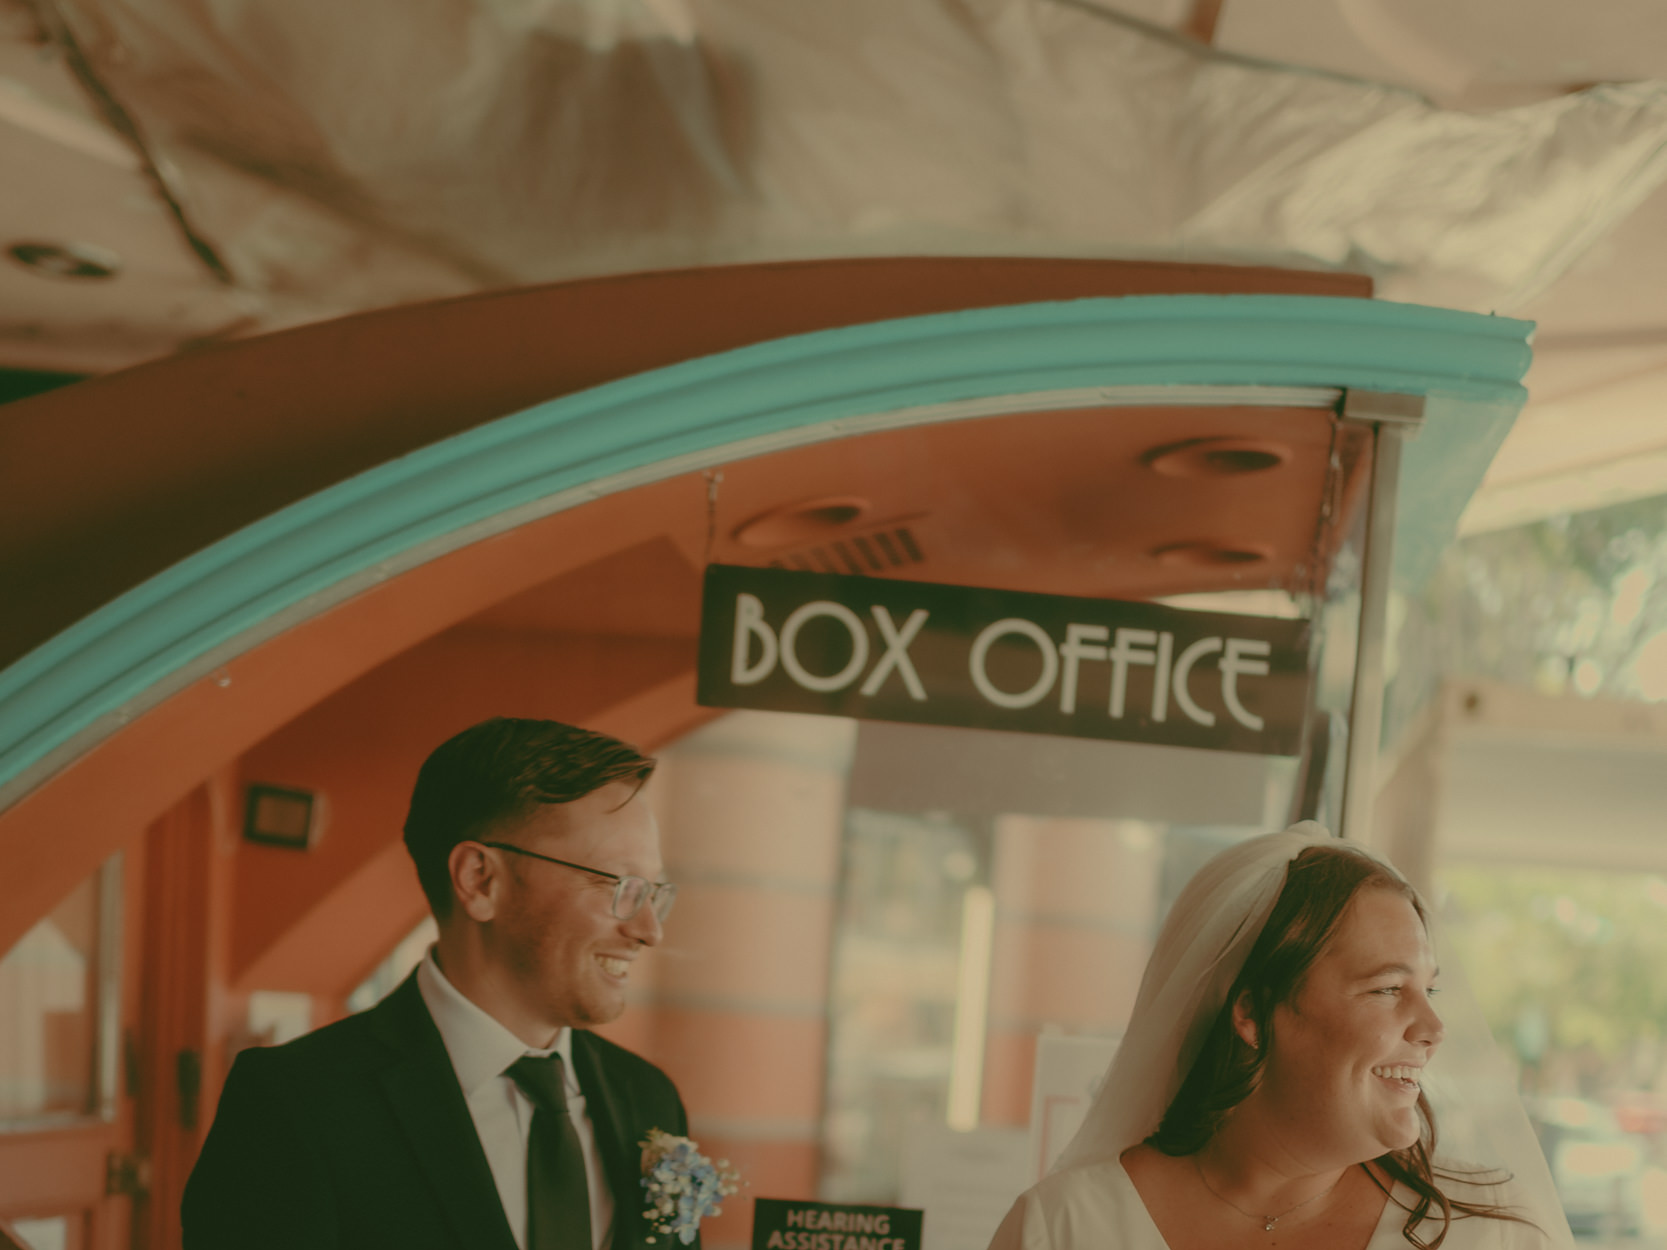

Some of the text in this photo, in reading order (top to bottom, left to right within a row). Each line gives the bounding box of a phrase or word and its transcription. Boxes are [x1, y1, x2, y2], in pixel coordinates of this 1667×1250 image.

[731, 593, 1272, 731] BOX OFFICE
[787, 1209, 891, 1236] HEARING
